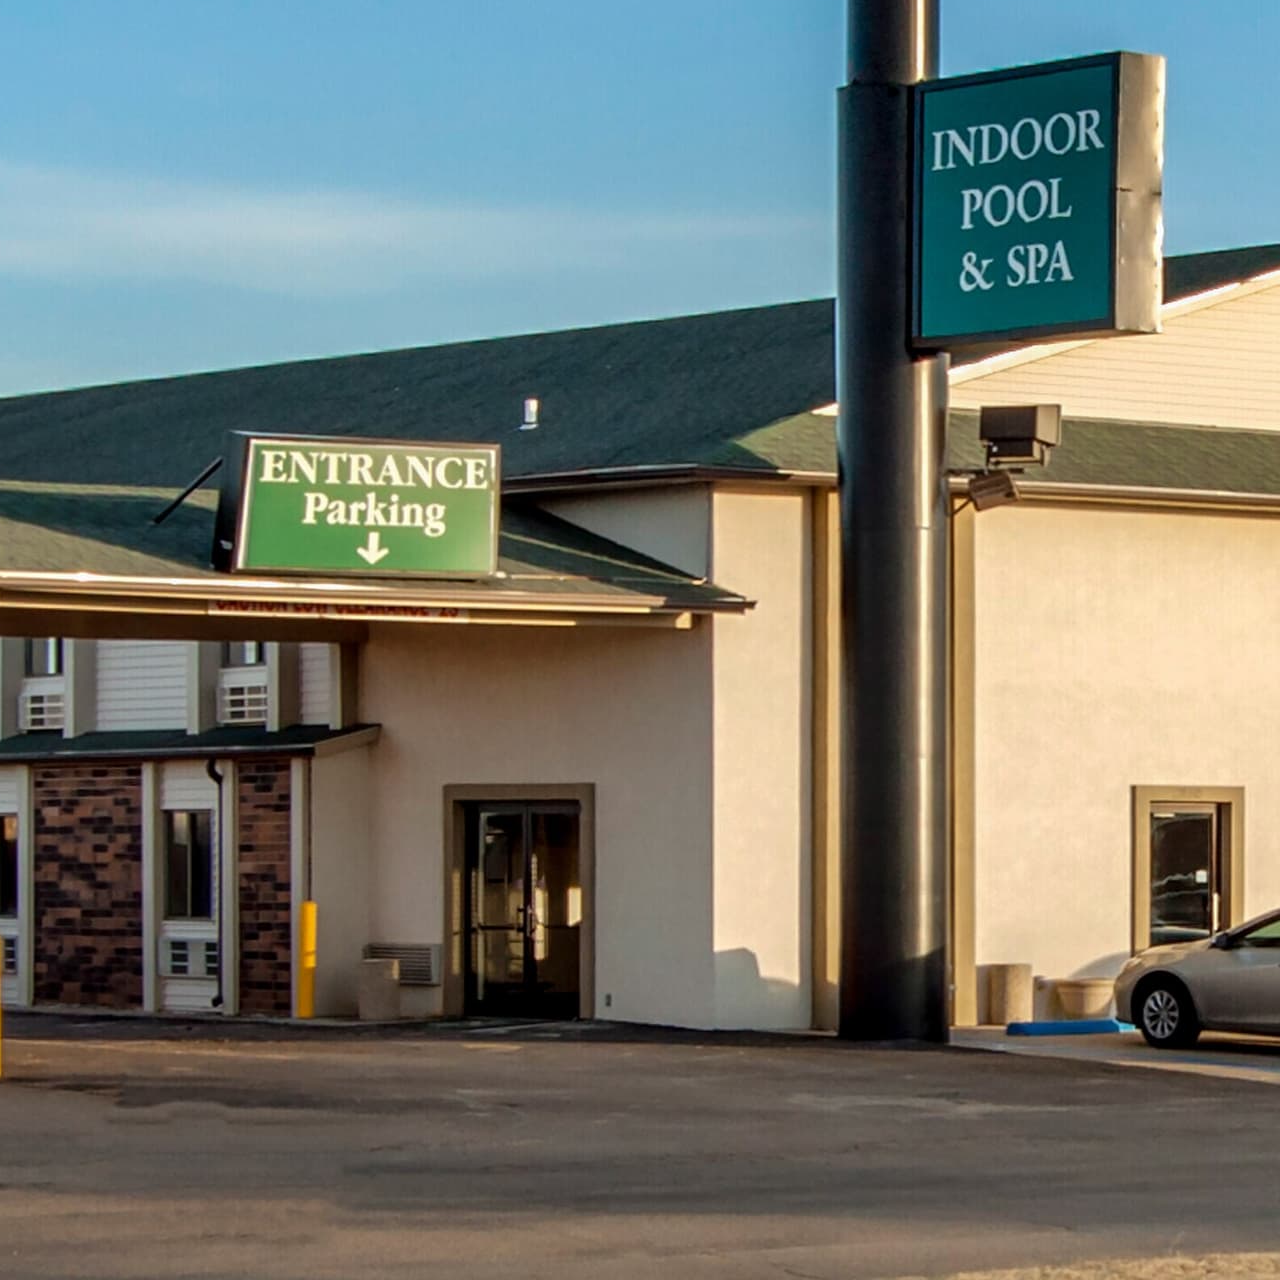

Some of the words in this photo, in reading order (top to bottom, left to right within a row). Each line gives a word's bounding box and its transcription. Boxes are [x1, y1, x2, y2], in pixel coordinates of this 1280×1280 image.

[930, 109, 1105, 171] INDOOR
[960, 177, 1073, 230] POOL
[959, 251, 995, 293] &
[1006, 240, 1075, 288] SPA
[259, 449, 489, 490] ENTRANCE
[301, 491, 447, 538] Parking
